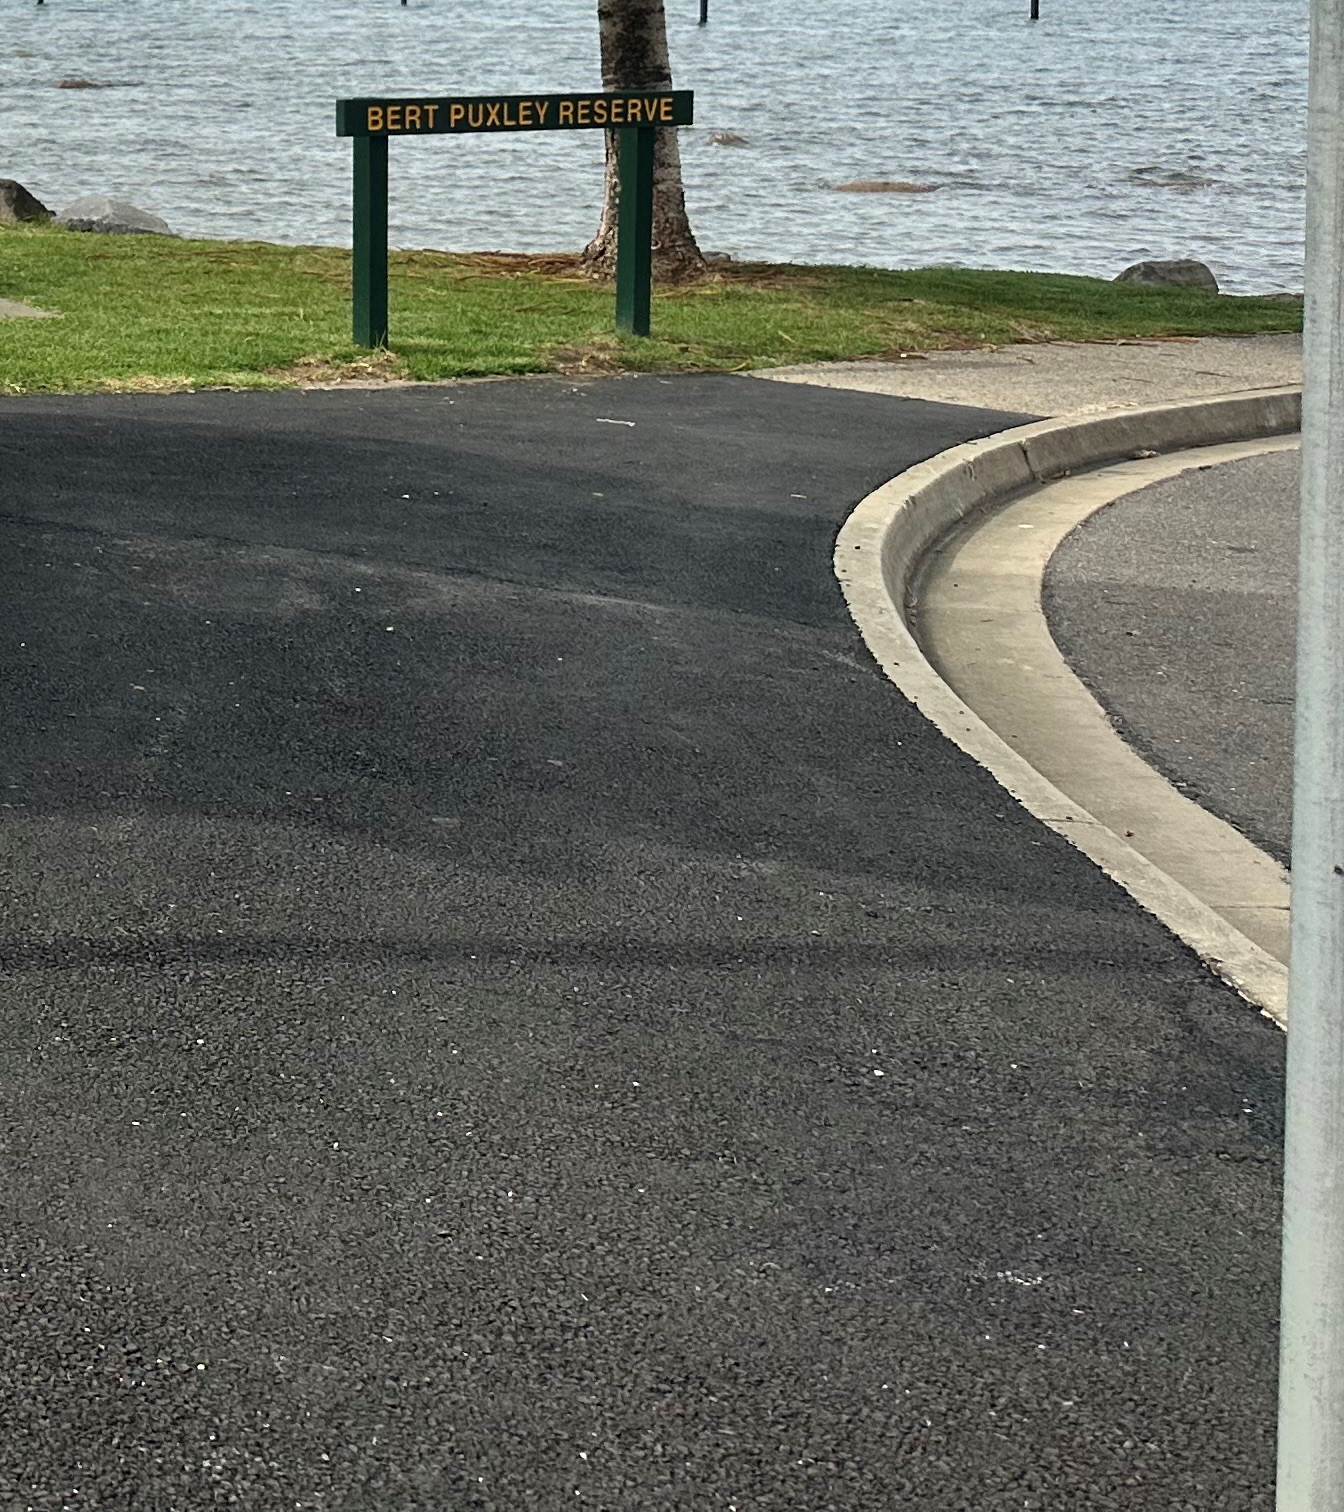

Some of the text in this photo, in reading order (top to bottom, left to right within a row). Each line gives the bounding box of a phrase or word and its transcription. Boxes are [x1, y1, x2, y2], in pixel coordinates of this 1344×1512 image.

[367, 97, 675, 132] BERT PUXLEY RESERVE
